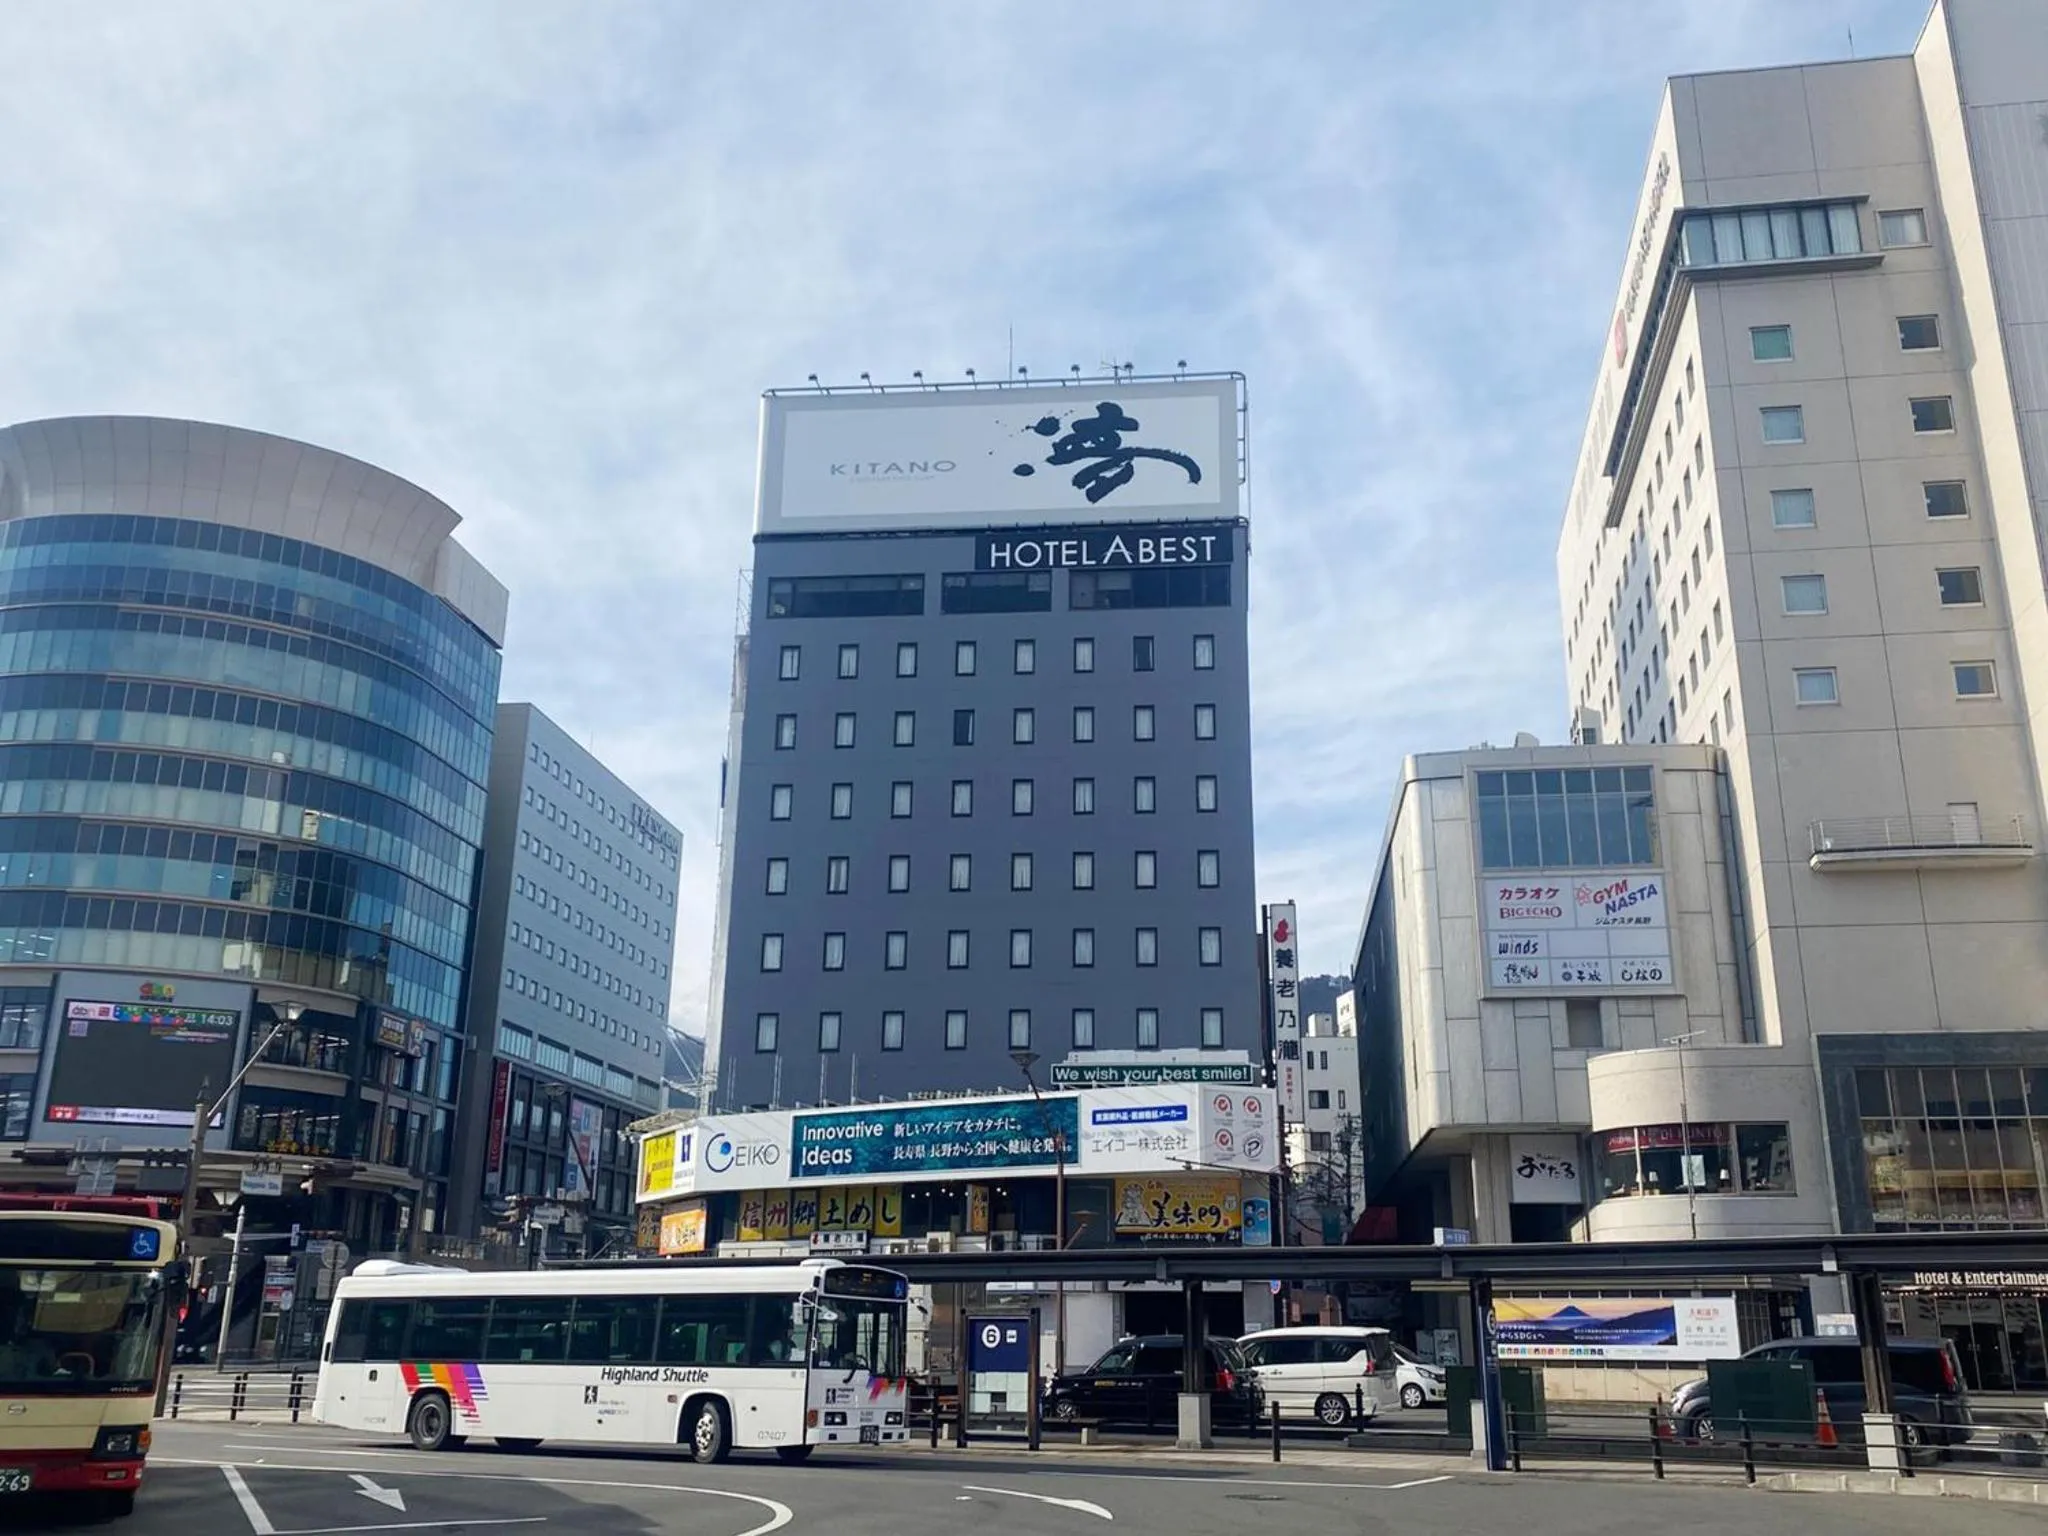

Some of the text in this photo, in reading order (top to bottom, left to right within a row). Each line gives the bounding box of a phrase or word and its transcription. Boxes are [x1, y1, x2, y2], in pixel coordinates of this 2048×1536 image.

[830, 460, 957, 476] KITANO
[989, 541, 1097, 569] HOTEL
[1499, 886, 1560, 900] カラオケ
[1593, 879, 1629, 905] GYM
[1604, 884, 1659, 916] NASTA
[1621, 968, 1663, 982] しなの
[1275, 948, 1299, 1060] 養老乃瀧
[201, 1013, 233, 1026] 14:03
[1055, 1066, 1248, 1085] We wish your best smile!
[803, 1122, 884, 1141] Innovative
[893, 1117, 1022, 1138] 新しいアイデアをカタチに。
[930, 1137, 1072, 1158] 長野から全国へ健康を発。
[1091, 1133, 1189, 1153] エイコー株式会社
[735, 1144, 781, 1166] EIKO
[802, 1147, 852, 1166] Ideas
[742, 1197, 897, 1229] 信州郷土めし
[1915, 1271, 1949, 1285] Hotel
[1951, 1272, 1962, 1284] &
[986, 1328, 997, 1344] 6
[601, 1367, 709, 1385] Highland Shuttle
